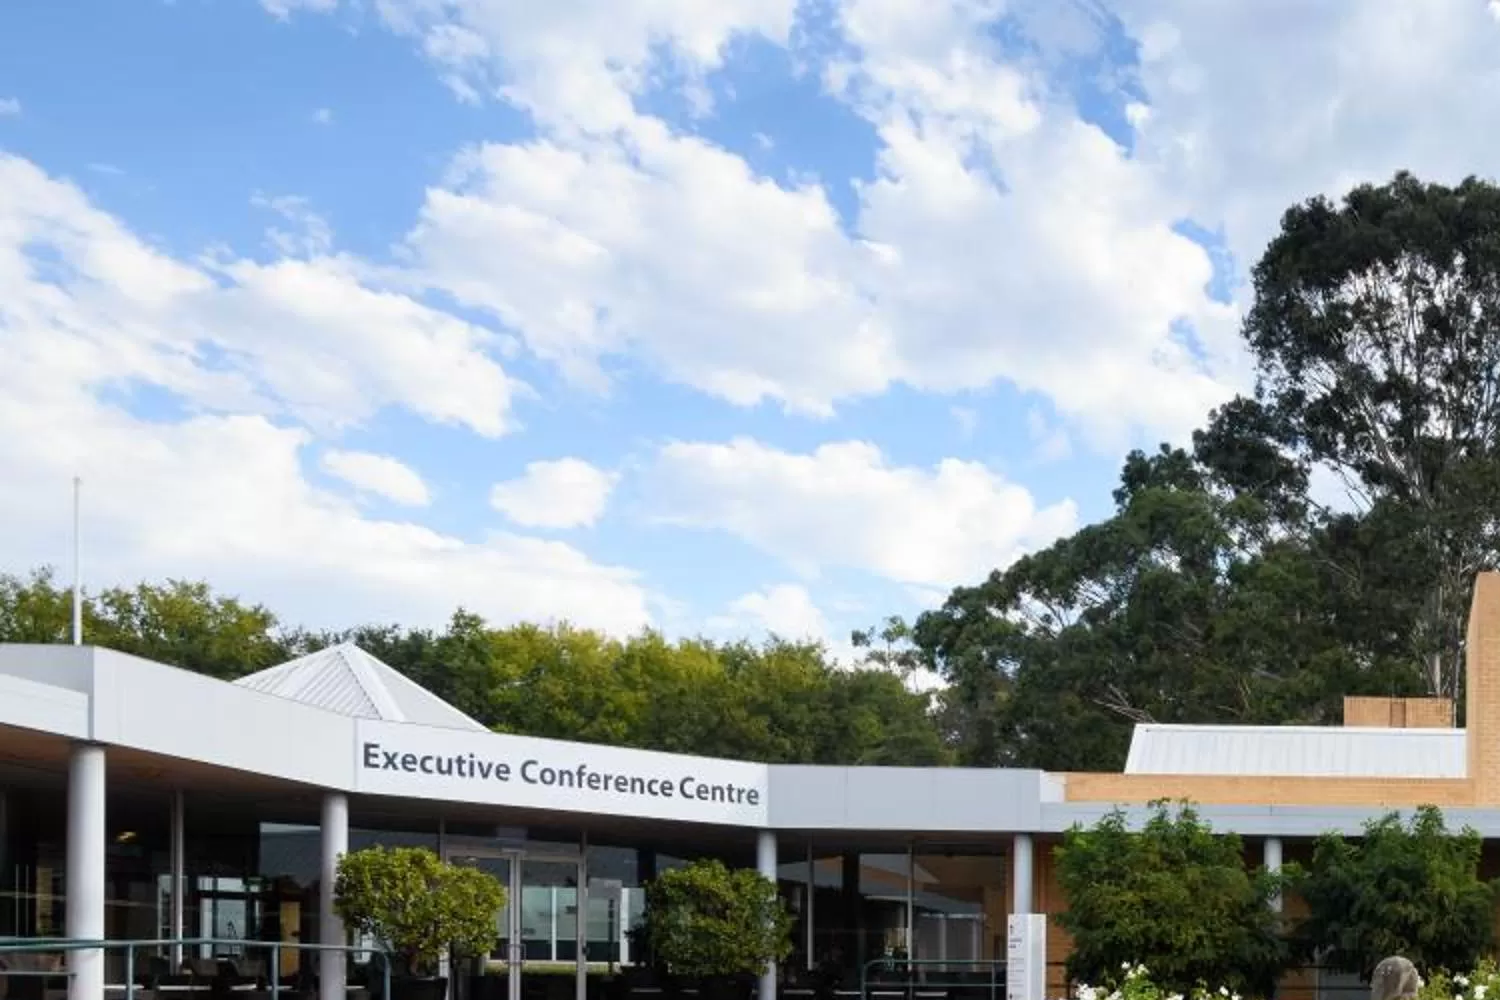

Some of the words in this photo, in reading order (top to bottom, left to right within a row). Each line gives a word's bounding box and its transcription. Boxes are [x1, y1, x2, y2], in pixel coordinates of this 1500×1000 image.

[362, 742, 511, 781] Executive
[521, 759, 674, 797] Conference
[679, 777, 760, 805] Centre
